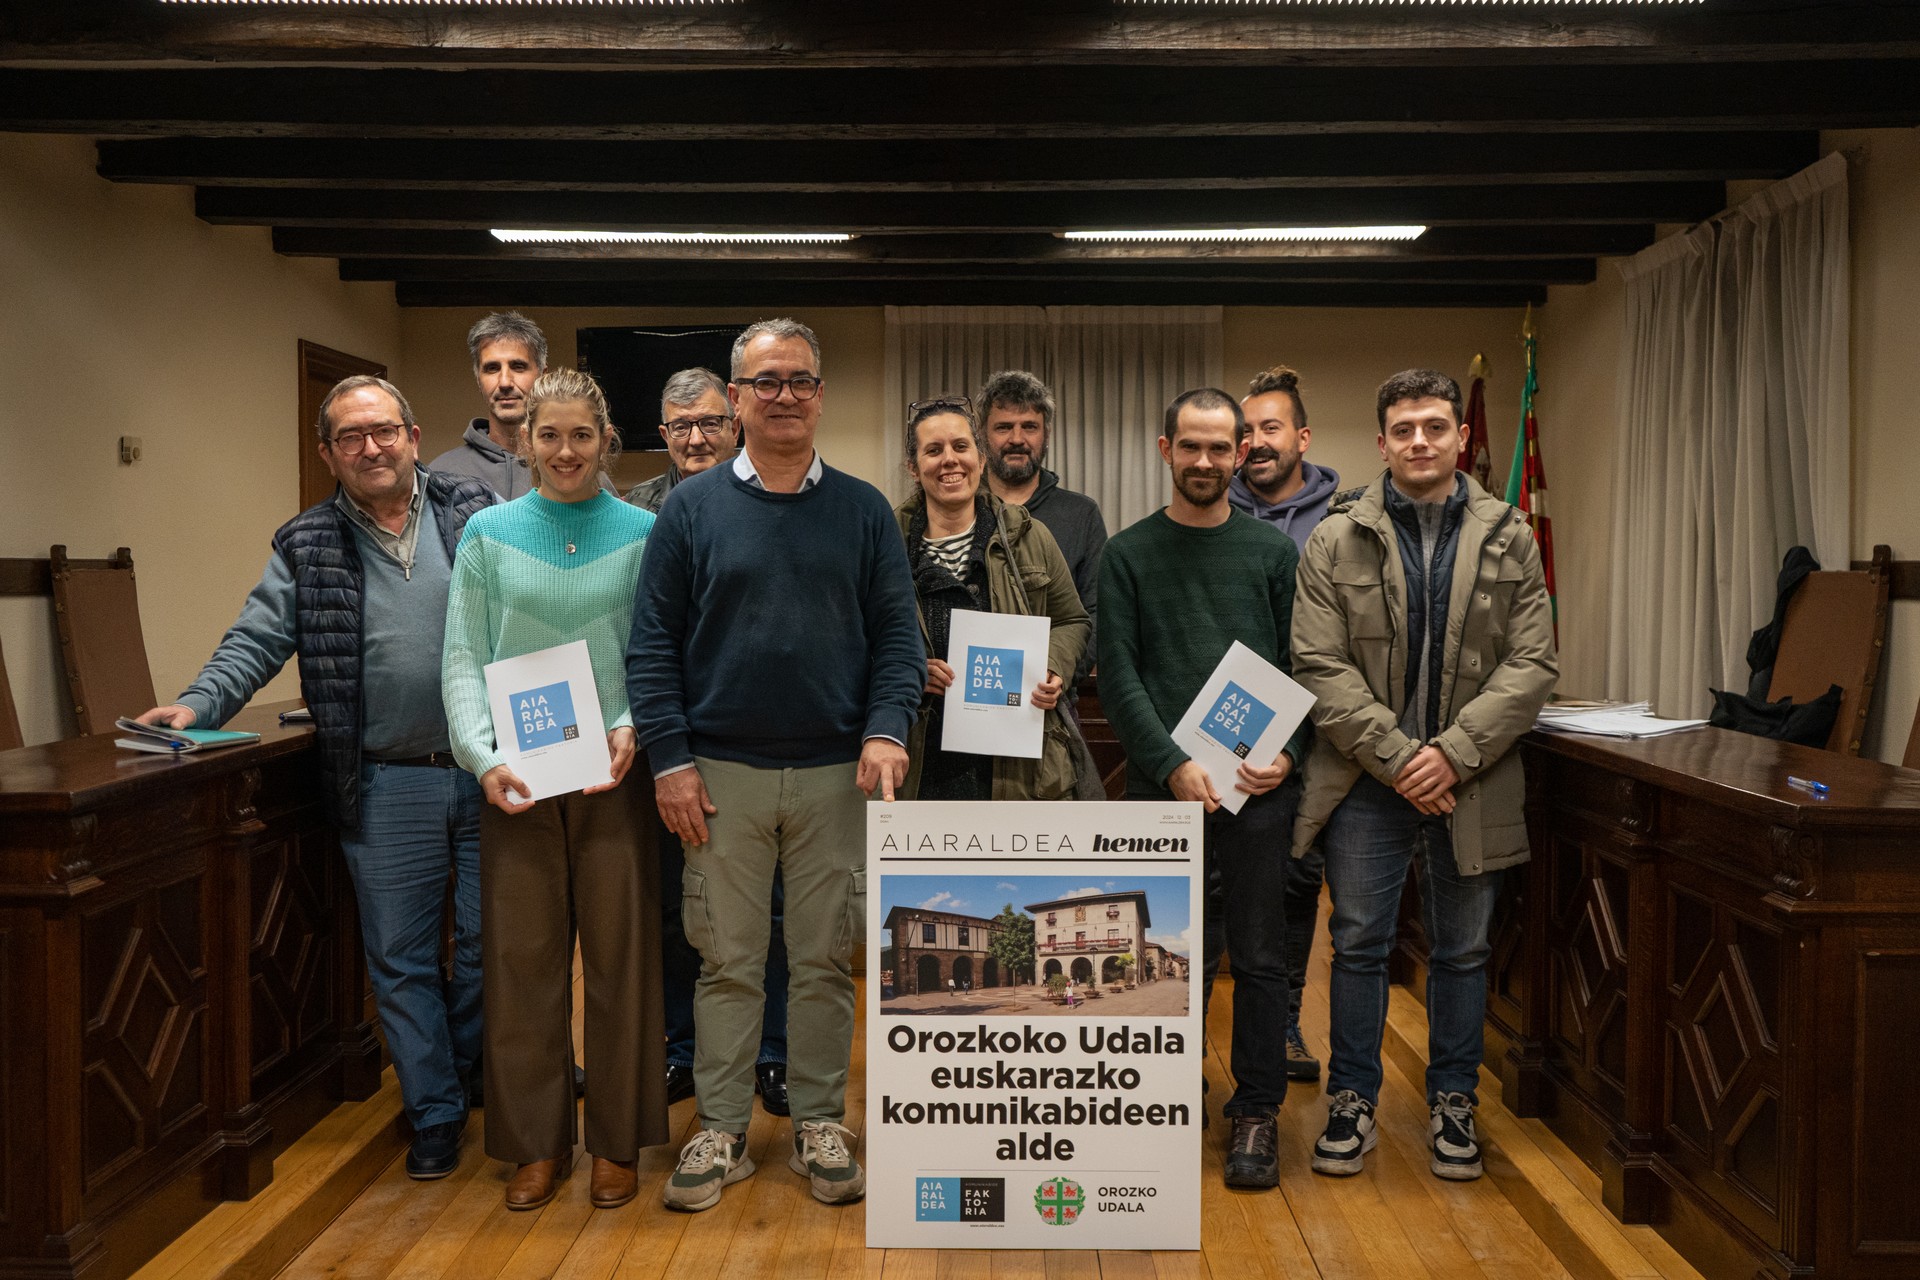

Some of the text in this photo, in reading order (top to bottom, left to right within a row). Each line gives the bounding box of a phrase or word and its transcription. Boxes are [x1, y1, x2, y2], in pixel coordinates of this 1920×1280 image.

[974, 654, 1001, 666] AIA
[973, 665, 1003, 678] RAL
[973, 677, 1004, 690] DEA
[520, 695, 548, 710] AIA
[1227, 692, 1251, 713] AIA
[521, 706, 553, 722] RAL
[1221, 702, 1245, 725] RAL
[524, 718, 557, 734] DEA
[1214, 711, 1241, 736] DEA
[881, 833, 1190, 853] AIARALDEA hemen
[887, 1024, 1185, 1055] Orozkoko Udala
[931, 1060, 1141, 1090] euskarazko
[882, 1095, 1189, 1126] komunikabideen
[995, 1131, 1075, 1161] alde
[921, 1182, 943, 1191] AIA
[965, 1190, 990, 1198] FAK
[1097, 1187, 1157, 1197] OROZKO
[921, 1191, 945, 1200] RAL
[921, 1201, 946, 1210] DEA
[965, 1208, 987, 1216] RIA
[1097, 1202, 1145, 1212] UDALA
